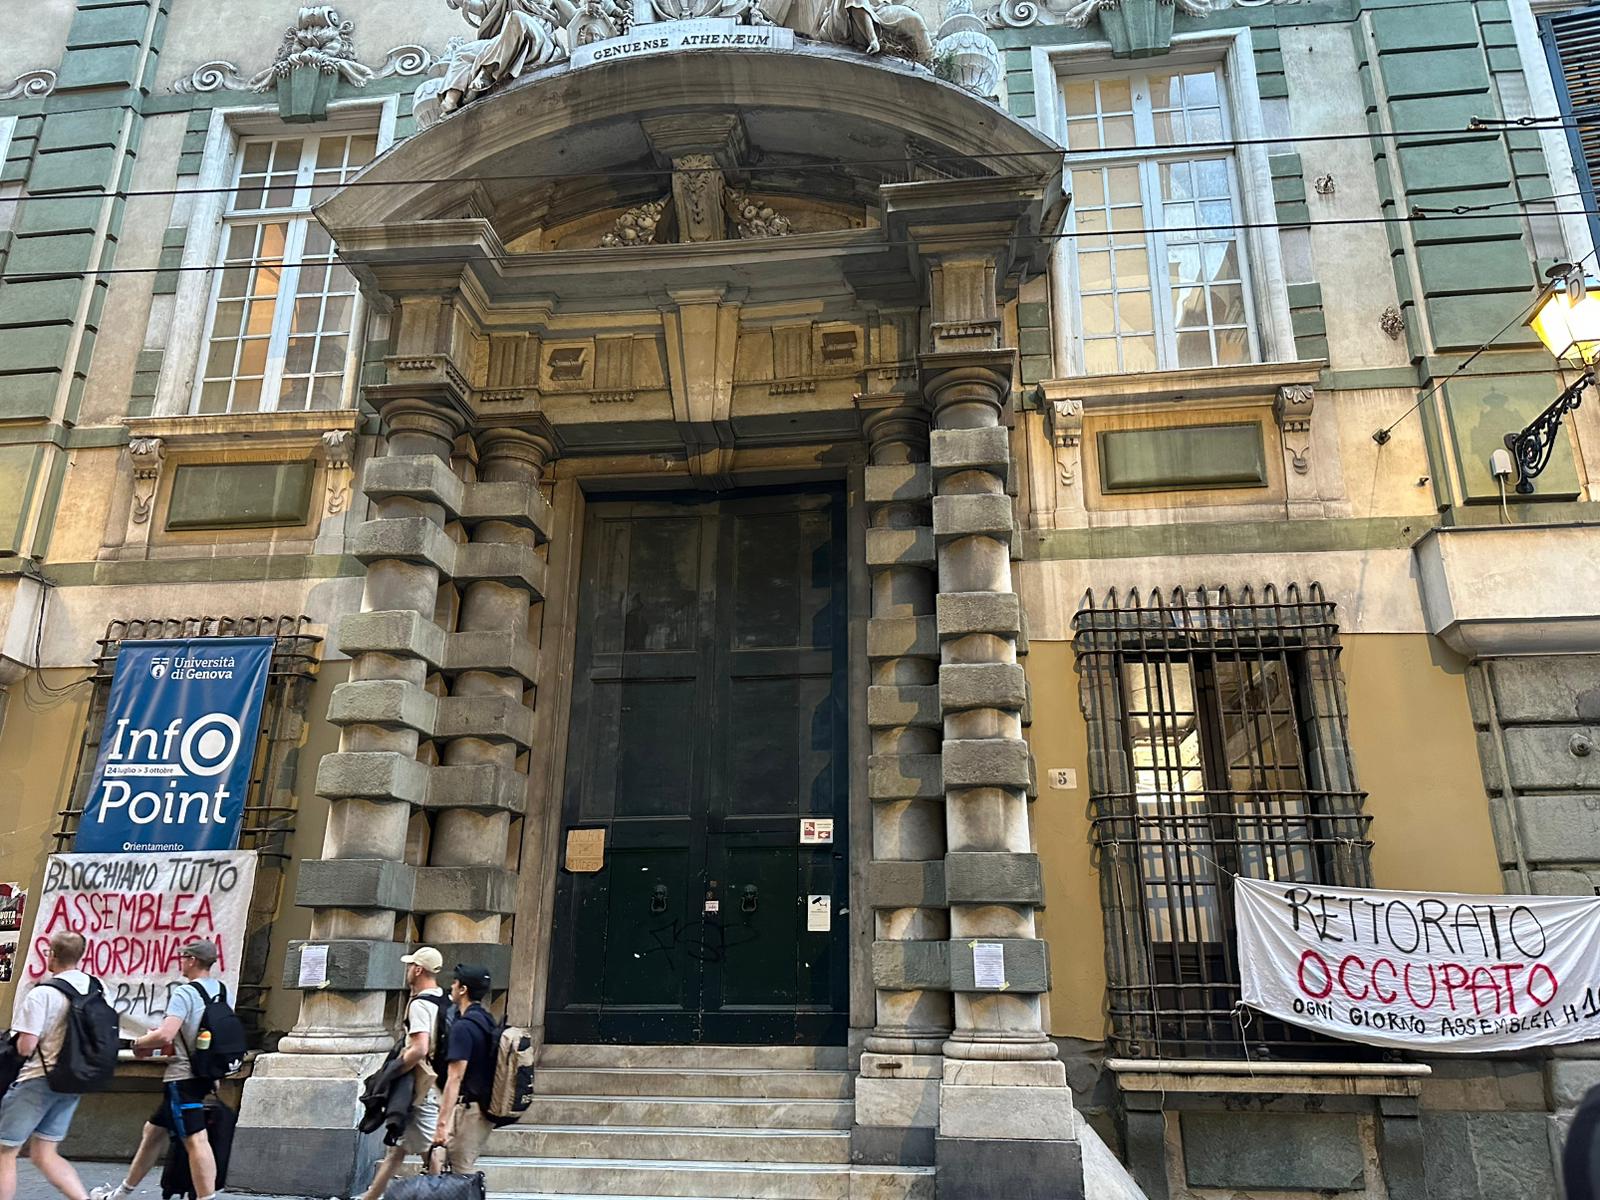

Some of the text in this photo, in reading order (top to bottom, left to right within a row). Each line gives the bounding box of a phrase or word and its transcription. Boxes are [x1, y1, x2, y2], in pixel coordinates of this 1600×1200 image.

[593, 38, 669, 60] GENUENSE
[171, 669, 233, 680] di Genova
[174, 656, 235, 668] Università
[118, 767, 136, 776] luglio
[1058, 772, 1067, 785] 5
[97, 780, 230, 824] Point
[123, 842, 184, 851] Orientamento
[43, 858, 238, 893] BLOCCHIAMO TUTTO
[45, 893, 214, 934] ASSEMBLEA
[1284, 887, 1546, 959] RETTORATO
[1297, 949, 1559, 1016] OCCUPATO
[1349, 1007, 1426, 1034] GIORNO
[1441, 1012, 1557, 1037] ASSEMBLEA
